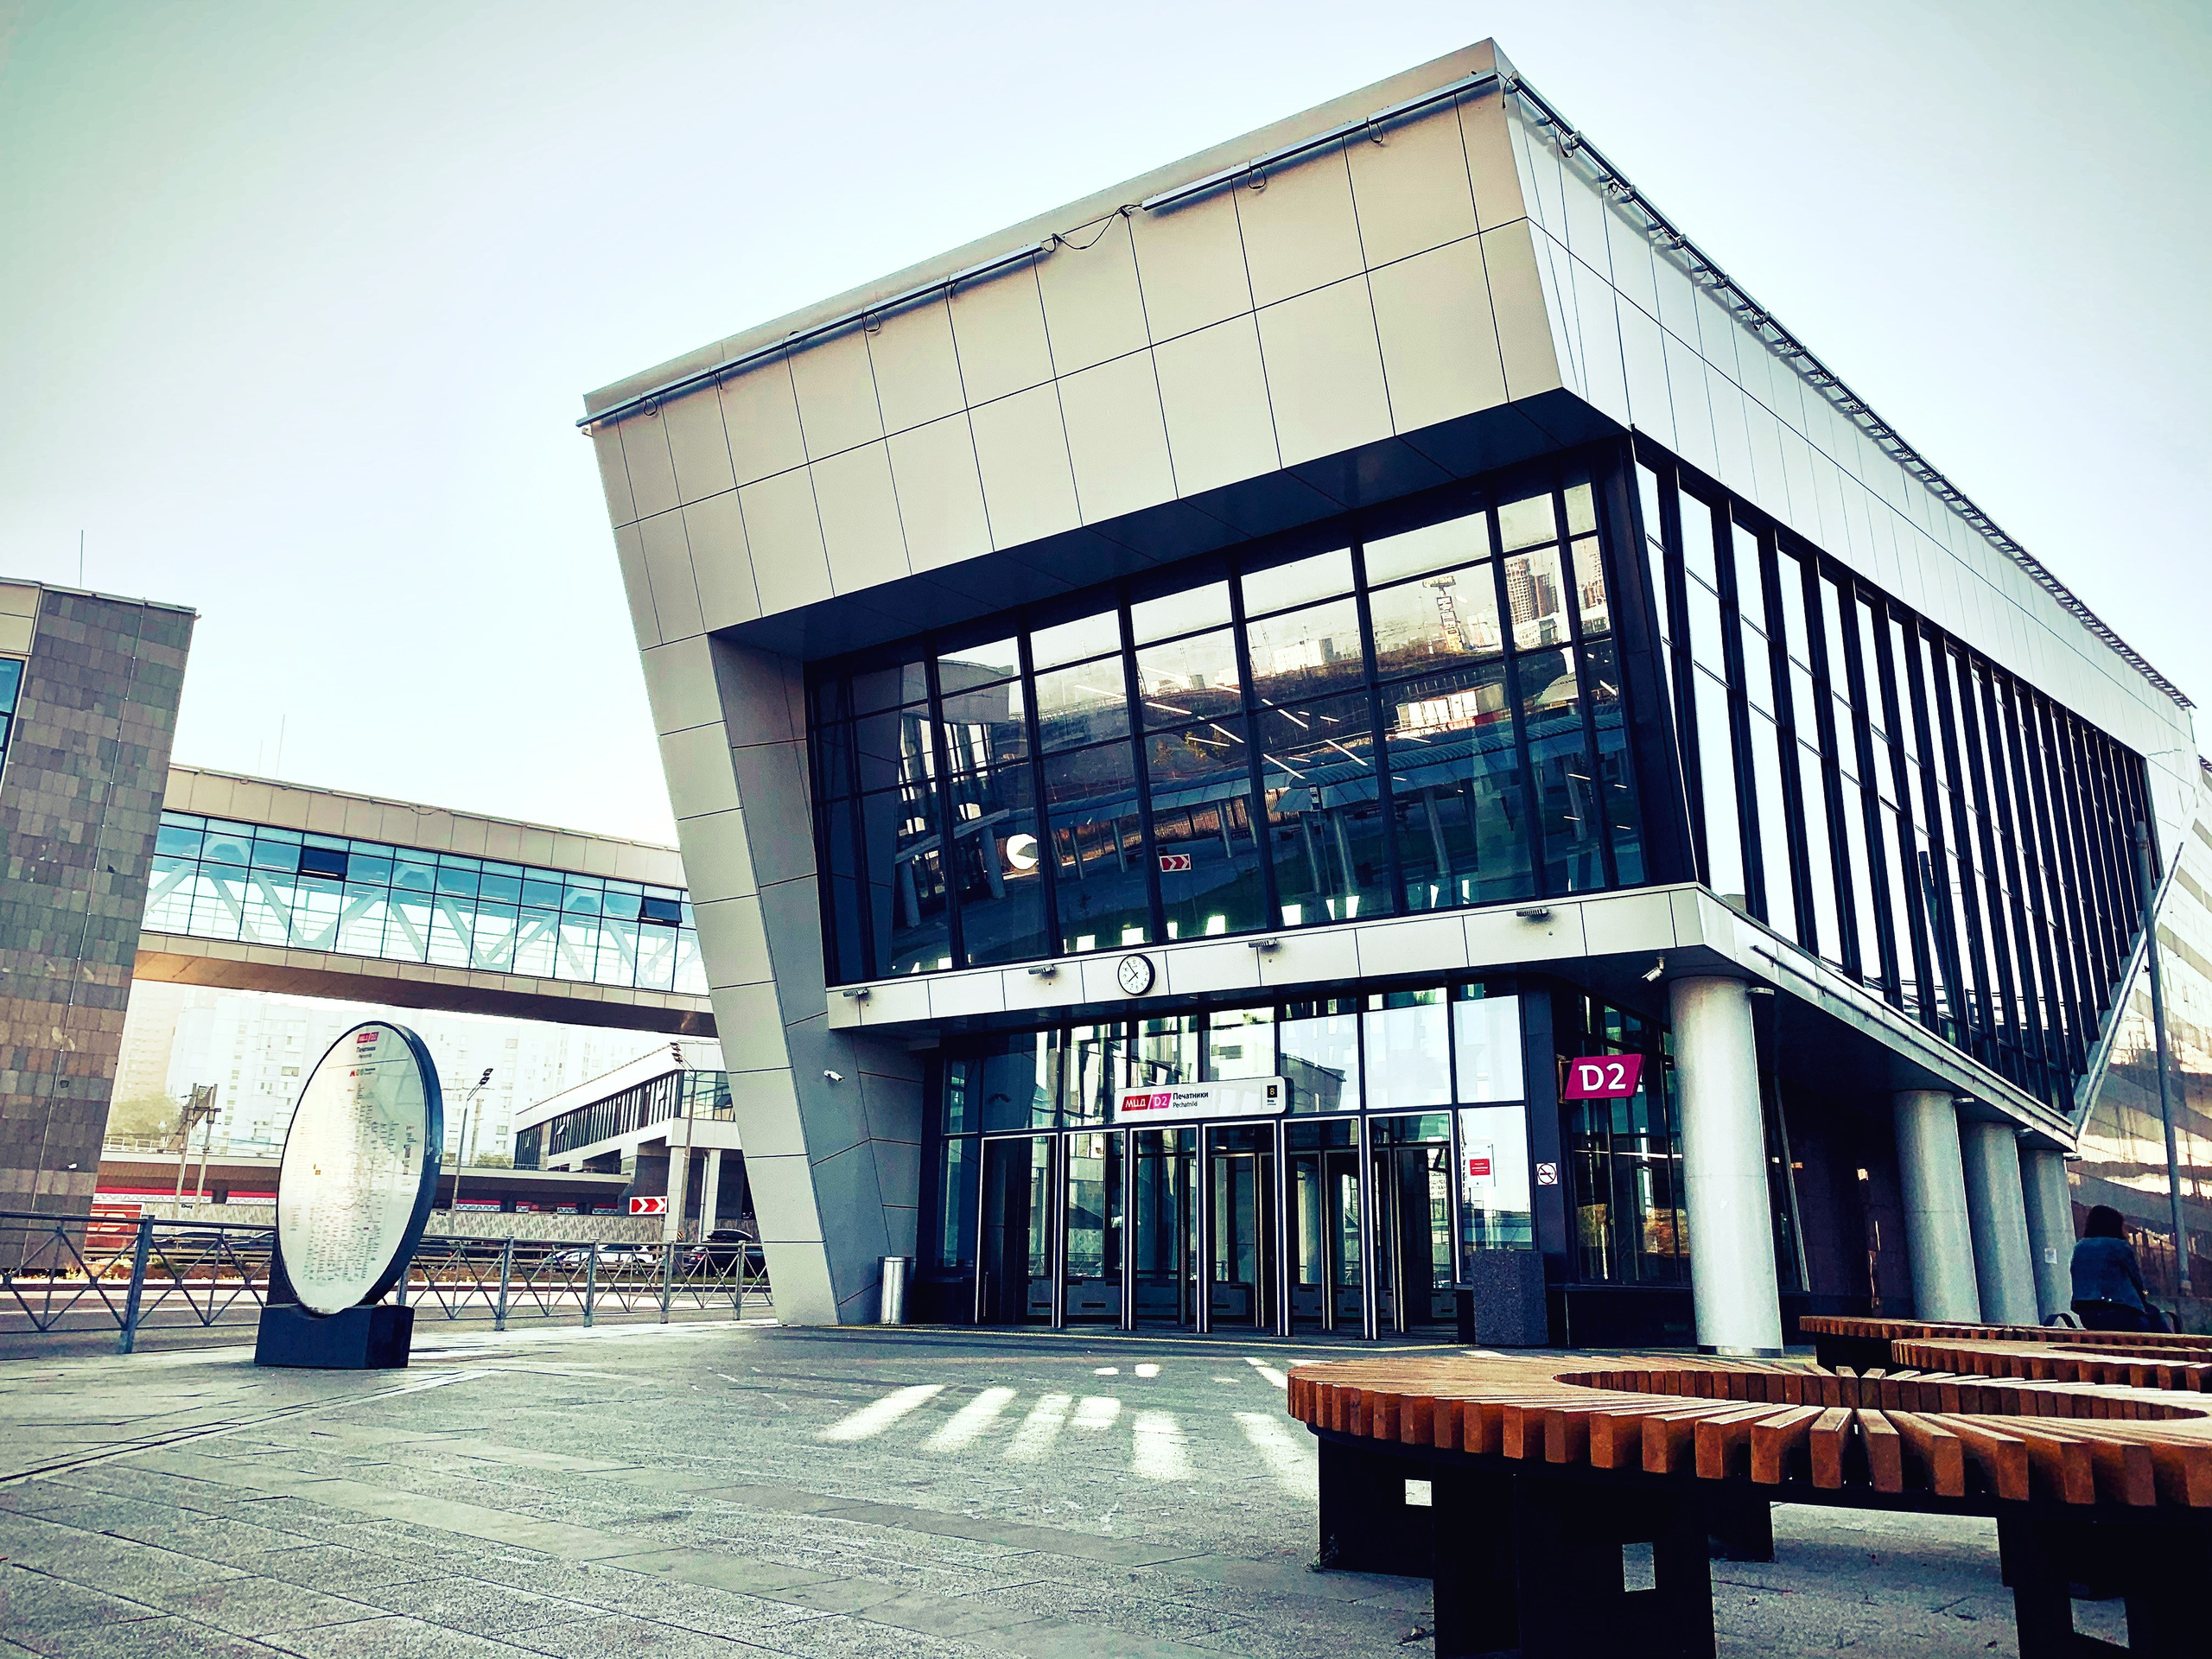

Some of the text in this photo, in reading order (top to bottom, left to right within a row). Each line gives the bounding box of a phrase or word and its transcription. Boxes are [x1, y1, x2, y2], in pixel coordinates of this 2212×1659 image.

[1578, 1063, 1626, 1091] D2
[1125, 1096, 1167, 1108] МЦД D2
